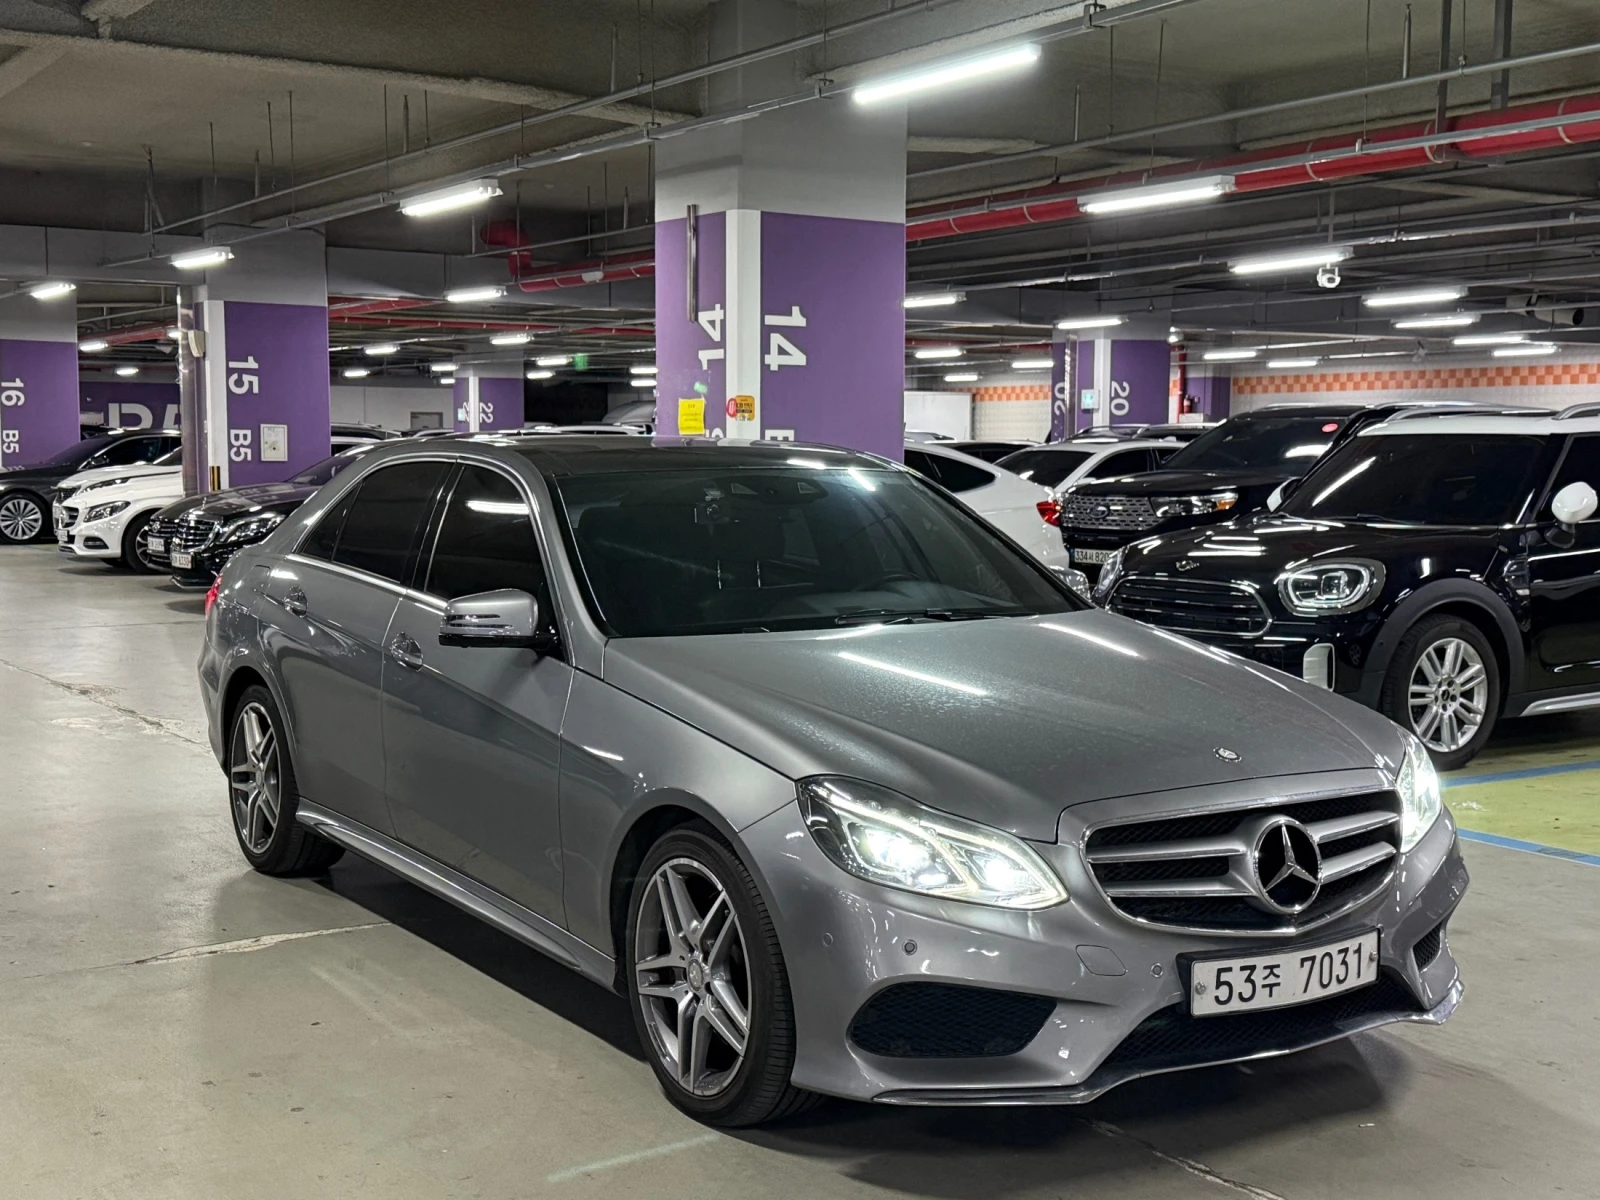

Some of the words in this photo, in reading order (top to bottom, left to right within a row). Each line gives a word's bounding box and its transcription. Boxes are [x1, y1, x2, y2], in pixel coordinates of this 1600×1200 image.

[698, 304, 724, 370] 14
[764, 306, 807, 371] 14
[1, 378, 25, 407] 16
[228, 356, 259, 394] 15
[480, 402, 494, 423] 22
[1111, 381, 1130, 416] 20
[2, 430, 20, 454] B5
[230, 429, 252, 462] B5
[1214, 964, 1281, 1005] 53주
[1300, 942, 1362, 994] 7031
